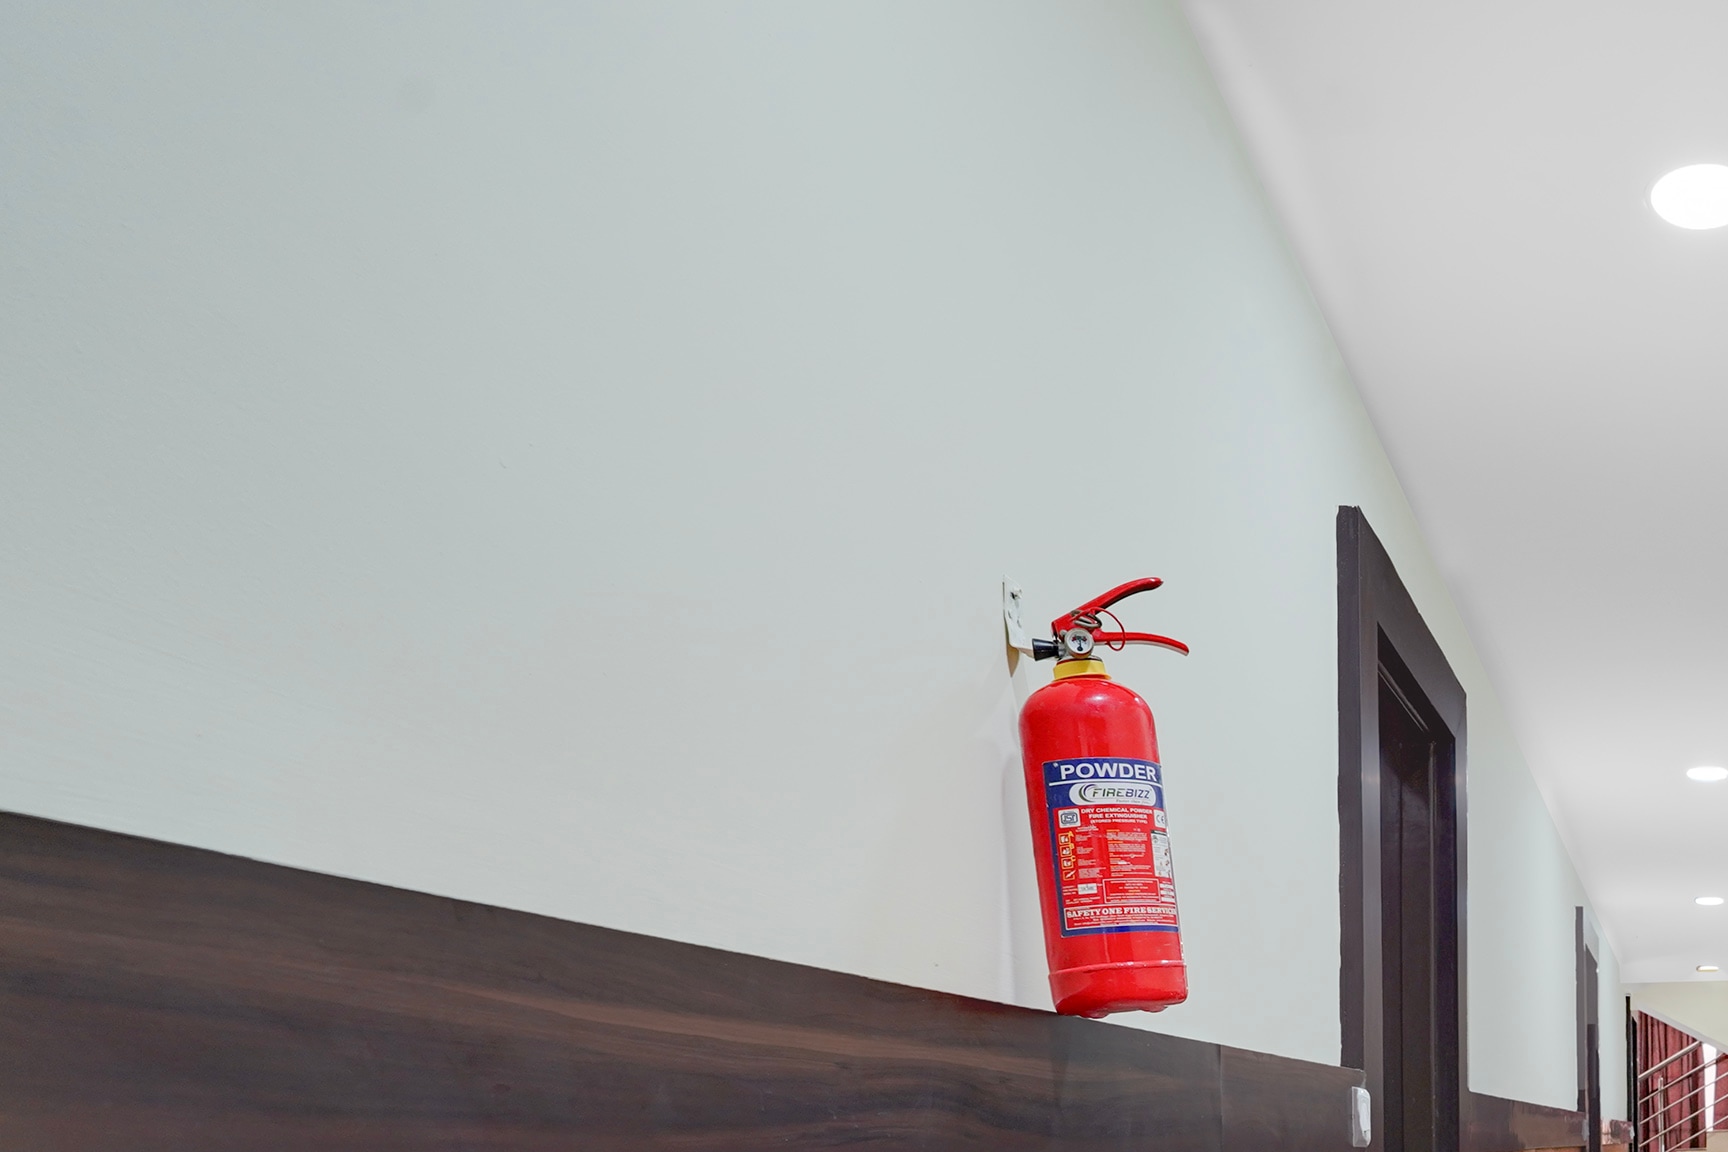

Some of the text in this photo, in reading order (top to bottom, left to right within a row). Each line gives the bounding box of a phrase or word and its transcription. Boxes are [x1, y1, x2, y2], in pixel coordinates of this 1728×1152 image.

[1060, 762, 1157, 781] POWDER
[1092, 787, 1150, 799] FIREBIZZ
[1066, 908, 1101, 918] SAFETY
[1102, 907, 1122, 915] ONE
